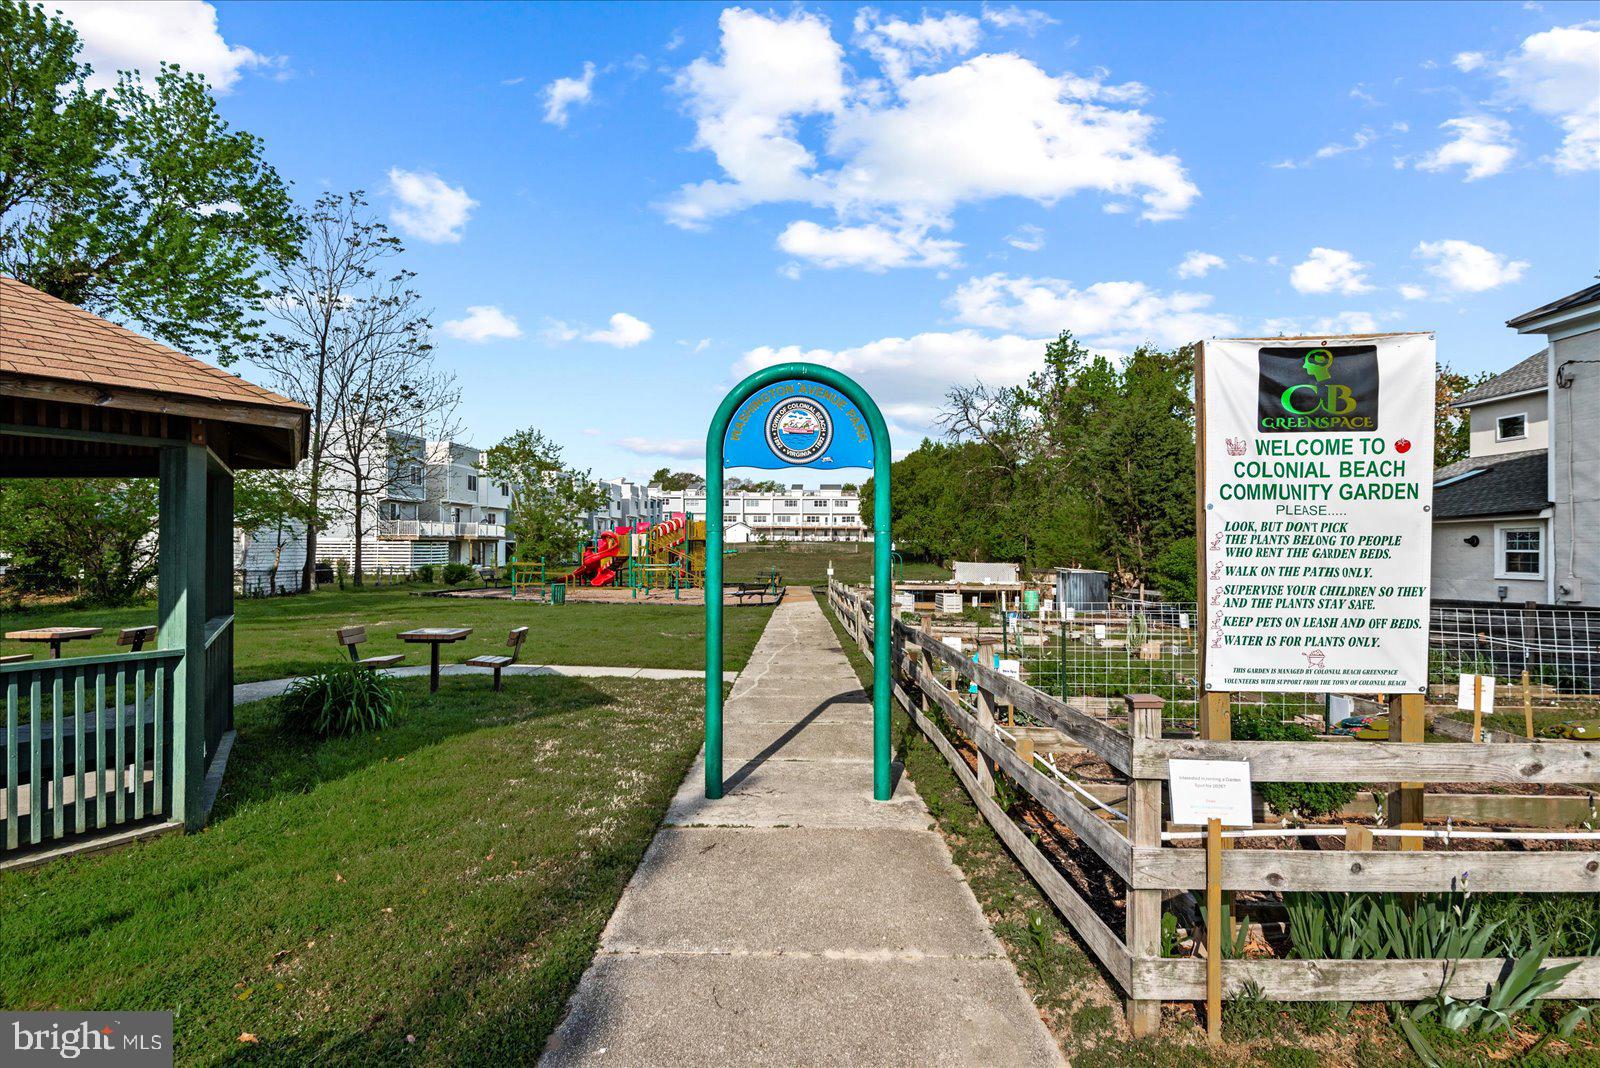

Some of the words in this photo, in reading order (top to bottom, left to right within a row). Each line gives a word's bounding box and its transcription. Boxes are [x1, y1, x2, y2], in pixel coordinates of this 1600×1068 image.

[1280, 384, 1357, 415] CB
[730, 384, 794, 441] WASHINGTON
[798, 384, 847, 412] AVENUE
[846, 408, 868, 443] PARK
[772, 414, 781, 431] TOWN
[779, 406, 788, 415] OF
[787, 403, 816, 413] COLONIAL
[815, 411, 826, 432] BEACH
[1261, 415, 1374, 430] GREENSPACE
[785, 449, 812, 457] VIRGINIA
[1255, 438, 1352, 456] WELCOME
[1357, 438, 1385, 455] TO
[1233, 462, 1330, 478] COLONIAL
[1339, 460, 1406, 478] BEACH
[1219, 483, 1334, 501] COMMUNITY
[1339, 483, 1418, 500] GARDEN
[1224, 521, 1257, 533] LOOK,
[1260, 522, 1283, 532] BUT
[1285, 522, 1318, 533] DON'T
[1320, 522, 1348, 533] PICK
[1224, 534, 1248, 545] THE
[1250, 534, 1290, 546] PLANTS
[1292, 535, 1336, 546] BELONG
[1340, 536, 1355, 546] TO
[1358, 536, 1402, 547] PEOPLE
[1226, 547, 1253, 558] WHO
[1255, 547, 1283, 558] RENT
[1287, 547, 1309, 559] THE
[1312, 548, 1357, 559] GARDEN
[1359, 548, 1391, 559] BEDS.
[1225, 566, 1258, 577] WALK
[1261, 566, 1276, 577] ON
[1279, 566, 1300, 577] THE
[1303, 566, 1340, 578] PATHS
[1342, 567, 1373, 578] ONLY.
[1223, 584, 1283, 596] SUPERVISE
[1287, 585, 1316, 596] YOUR
[1319, 585, 1376, 597] CHILDREN
[1378, 586, 1394, 597] SO
[1397, 586, 1426, 597] THEY
[1223, 598, 1248, 608] AND
[1251, 598, 1272, 609] THE
[1275, 598, 1315, 609] PLANTS
[1317, 598, 1346, 609] STAY
[1348, 599, 1375, 610] SAFE.
[1223, 616, 1253, 628] KEEP
[1256, 617, 1282, 628] PETS
[1285, 617, 1300, 628] ON
[1303, 617, 1337, 628] LEASH
[1340, 618, 1365, 629] AND
[1369, 618, 1388, 629] OFF
[1391, 618, 1422, 629] BEDS.
[1224, 635, 1262, 647] WATER
[1266, 636, 1276, 647] IS
[1279, 636, 1301, 647] FOR
[1304, 636, 1345, 647] PLANTS
[1348, 636, 1380, 648] ONLY.
[1362, 668, 1399, 676] GREENSPACE
